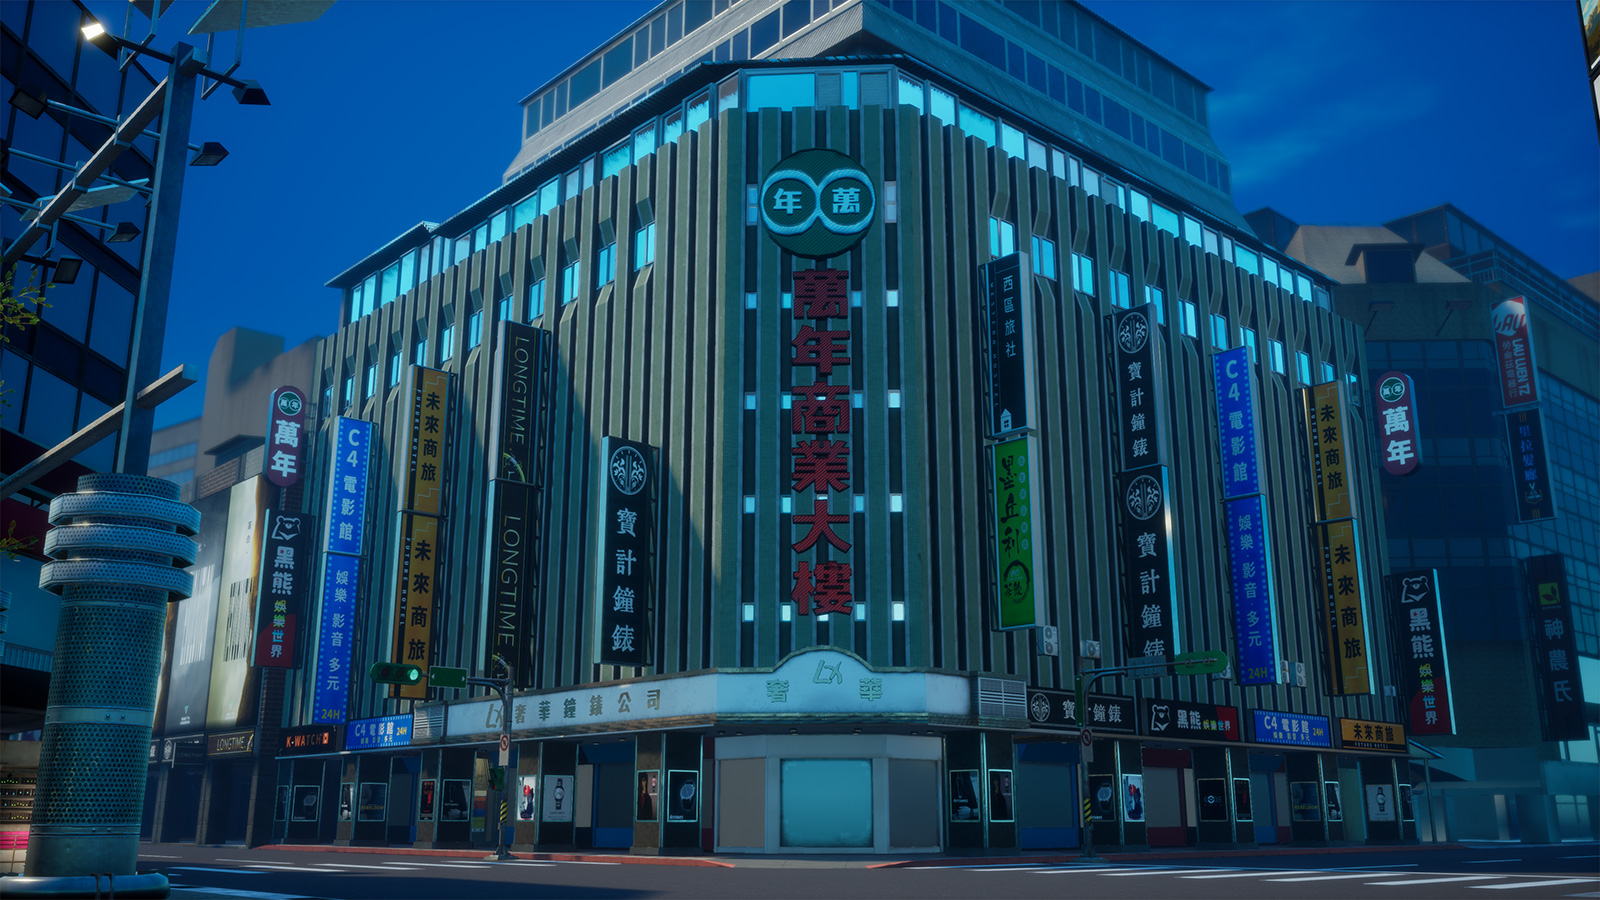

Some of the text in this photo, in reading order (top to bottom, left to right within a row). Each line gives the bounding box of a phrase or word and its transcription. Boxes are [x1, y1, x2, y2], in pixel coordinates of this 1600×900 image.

[773, 187, 861, 215] 年 萬
[1003, 275, 1017, 358] 西區旅社
[1512, 338, 1526, 357] LAU
[413, 388, 421, 432] FUTURE
[1128, 361, 1149, 458] 寶計鐘錶
[1515, 357, 1529, 383] LUEN
[270, 419, 301, 478] 萬年
[421, 392, 441, 482] 未來商旅
[792, 269, 853, 615] 萬年商業大樓
[1311, 407, 1322, 487] FUTURE HOTEL
[1320, 404, 1343, 490] 未來商旅
[1382, 405, 1414, 465] 萬年
[270, 545, 295, 659] 黑熊 娛樂世界
[399, 537, 411, 626] FUTURE HOTEL
[407, 540, 432, 661] 未來商旅
[610, 507, 638, 653] 寶計鐘錶
[1136, 532, 1165, 657] 寶計鐘錶
[1323, 546, 1337, 629] FUTURE HOTEL
[1334, 544, 1362, 659] 未來商旅
[1248, 667, 1268, 680] 24H
[1409, 607, 1438, 725] 黑熊 娛樂世界
[1544, 617, 1573, 703] 神農氏
[321, 708, 341, 720] 24H
[1062, 699, 1122, 723] 寶鐘錶
[1177, 709, 1202, 730] 黑熊
[1353, 722, 1395, 742] 未來商旅
